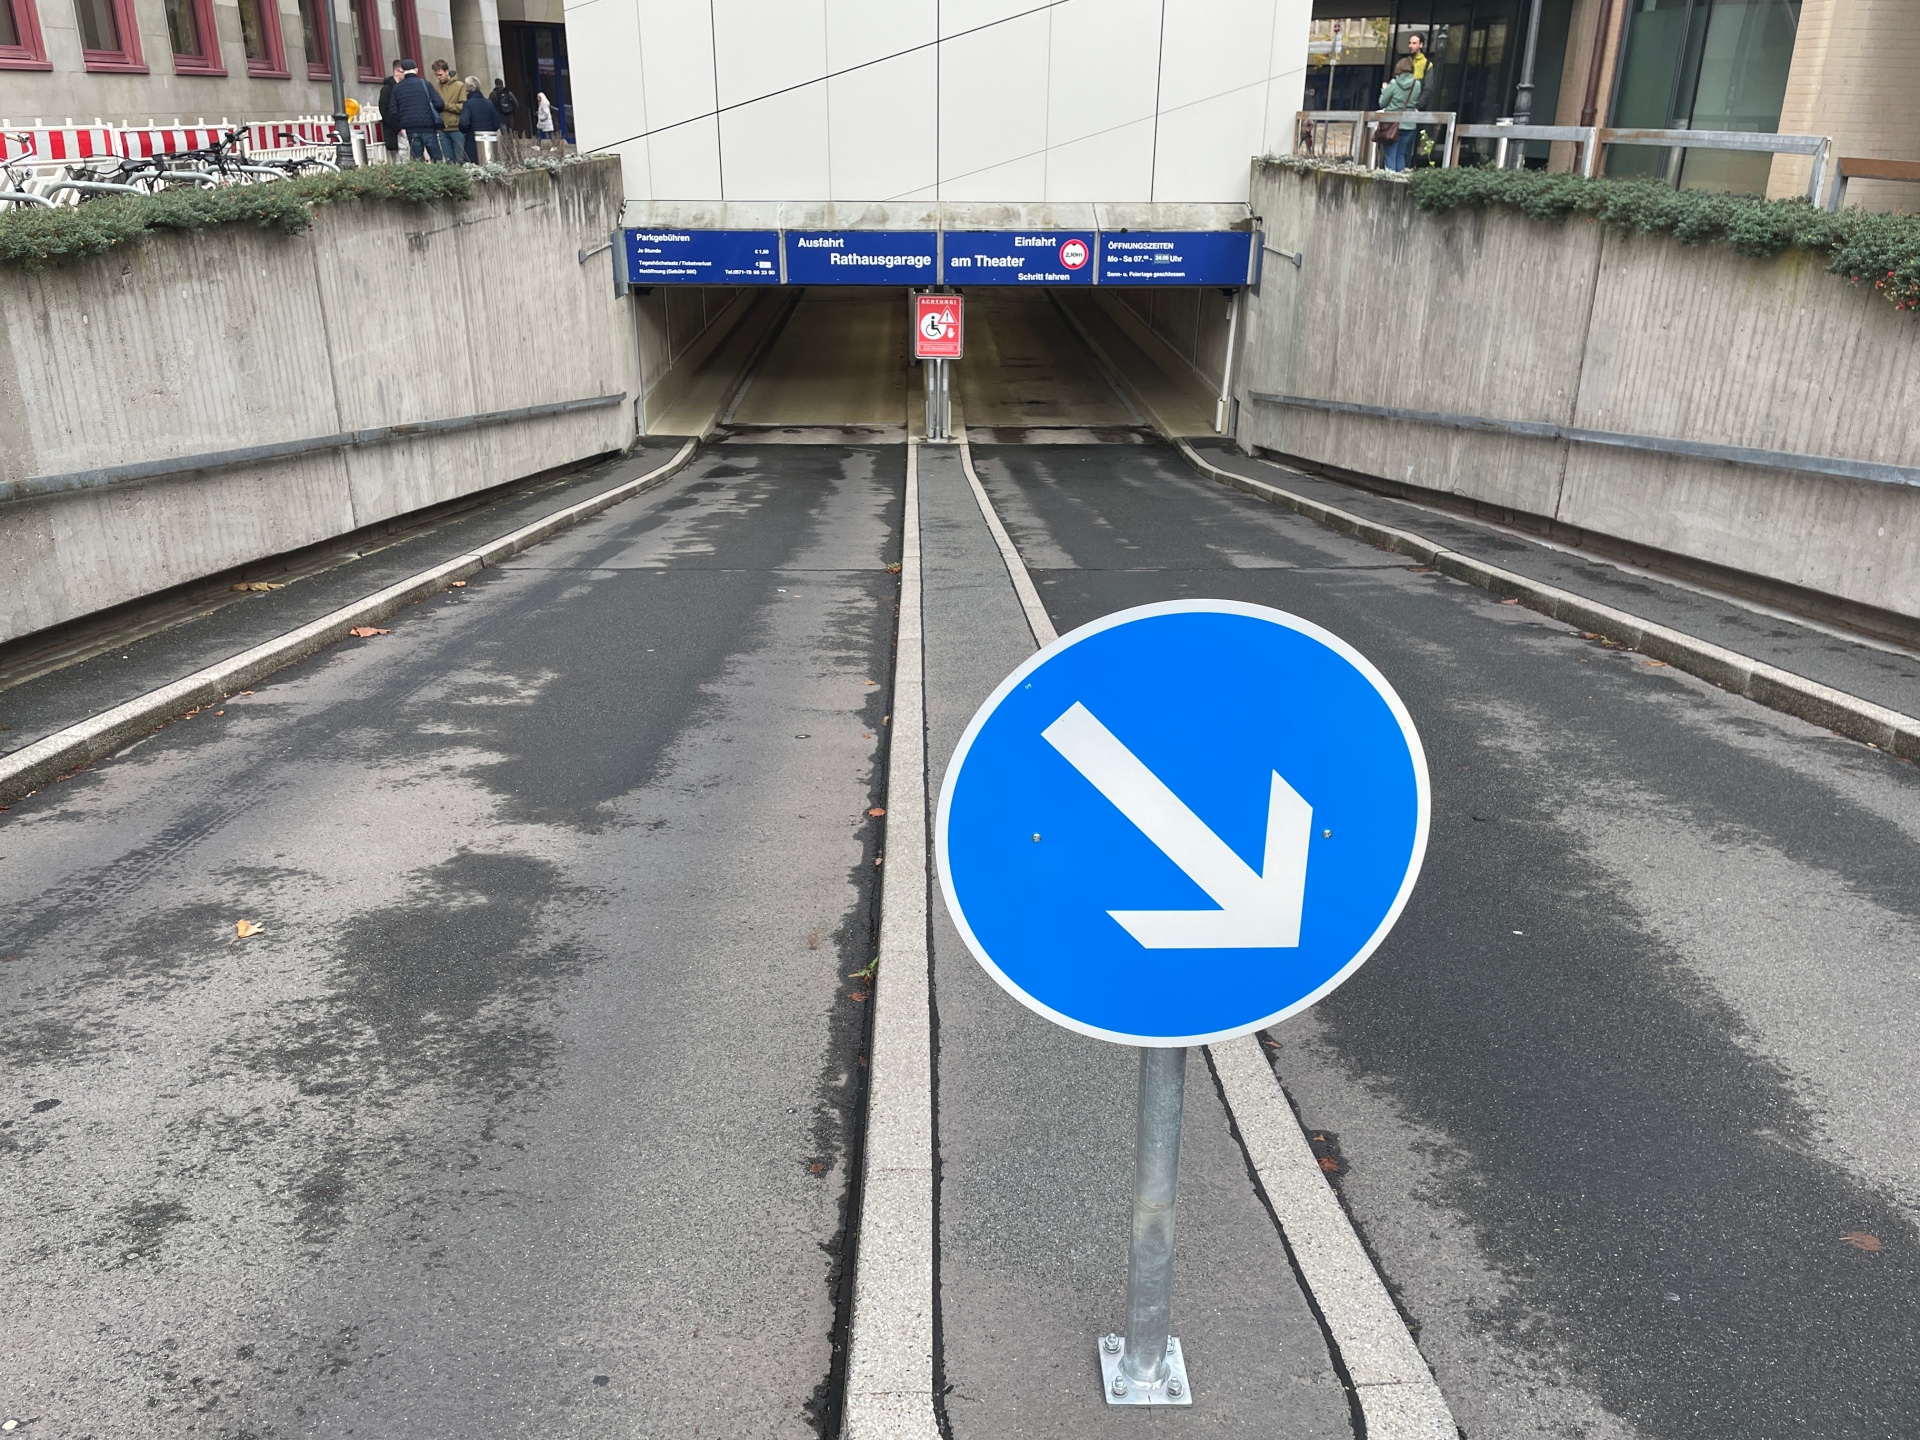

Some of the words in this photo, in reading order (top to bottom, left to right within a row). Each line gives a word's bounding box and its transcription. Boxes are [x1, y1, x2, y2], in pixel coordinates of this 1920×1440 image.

[636, 233, 690, 243] Parkgebühren
[797, 237, 844, 248] Ausfahrt
[1014, 236, 1056, 247] Einfahrt
[1107, 241, 1174, 250] ÖFFNUNGSZEITEN
[830, 253, 932, 268] Rathausgarage
[951, 257, 971, 267] am
[974, 254, 1025, 267] Theater
[1017, 273, 1043, 281] Schritt
[1045, 273, 1070, 281] fahren
